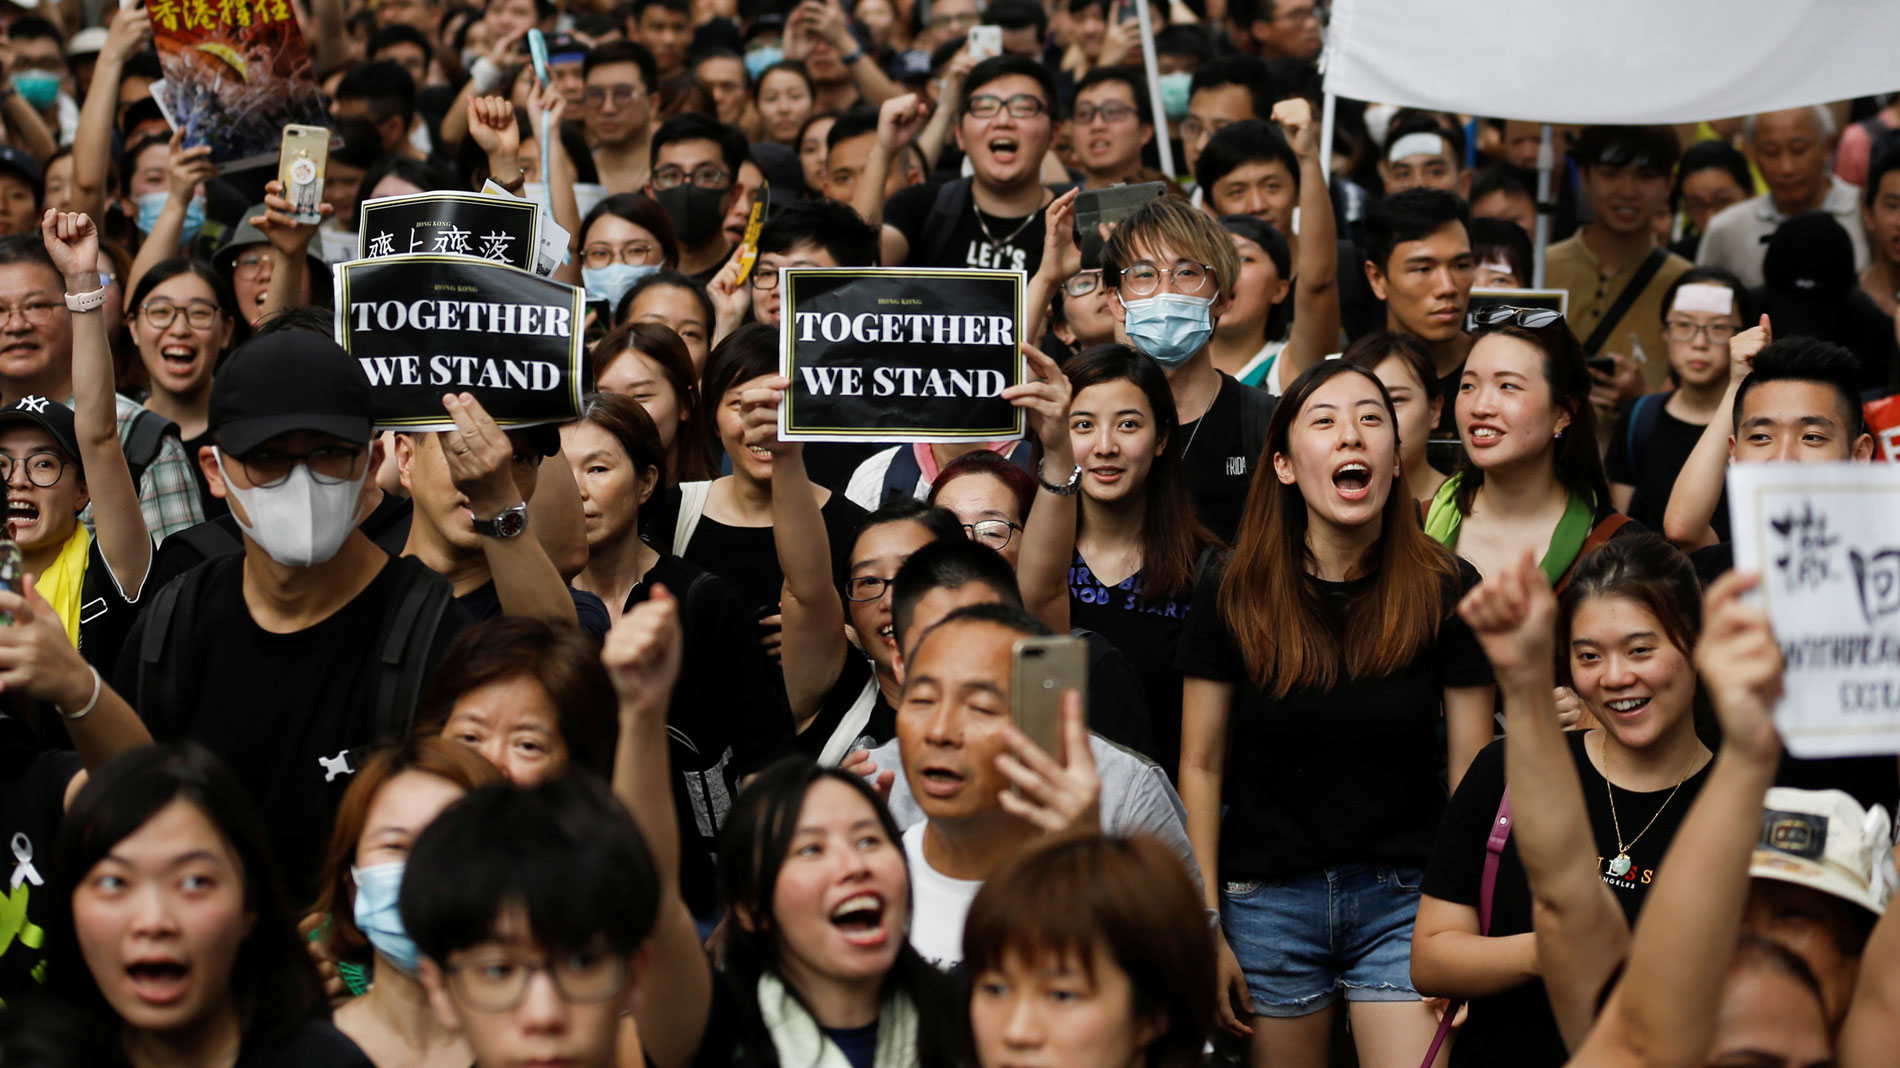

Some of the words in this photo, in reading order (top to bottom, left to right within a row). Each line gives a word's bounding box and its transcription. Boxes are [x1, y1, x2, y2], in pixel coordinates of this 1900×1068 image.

[966, 240, 1026, 270] LET'S
[434, 284, 456, 292] HONG
[457, 285, 478, 293] KONG
[351, 300, 571, 337] TOGETHER
[795, 312, 1015, 346] TOGETHER
[358, 355, 422, 387] WE
[429, 355, 561, 391] STAND
[800, 366, 864, 396] WE
[872, 366, 1006, 398] STAND
[1783, 635, 1900, 672] WITHDRA
[1599, 876, 1635, 889] NGELES
